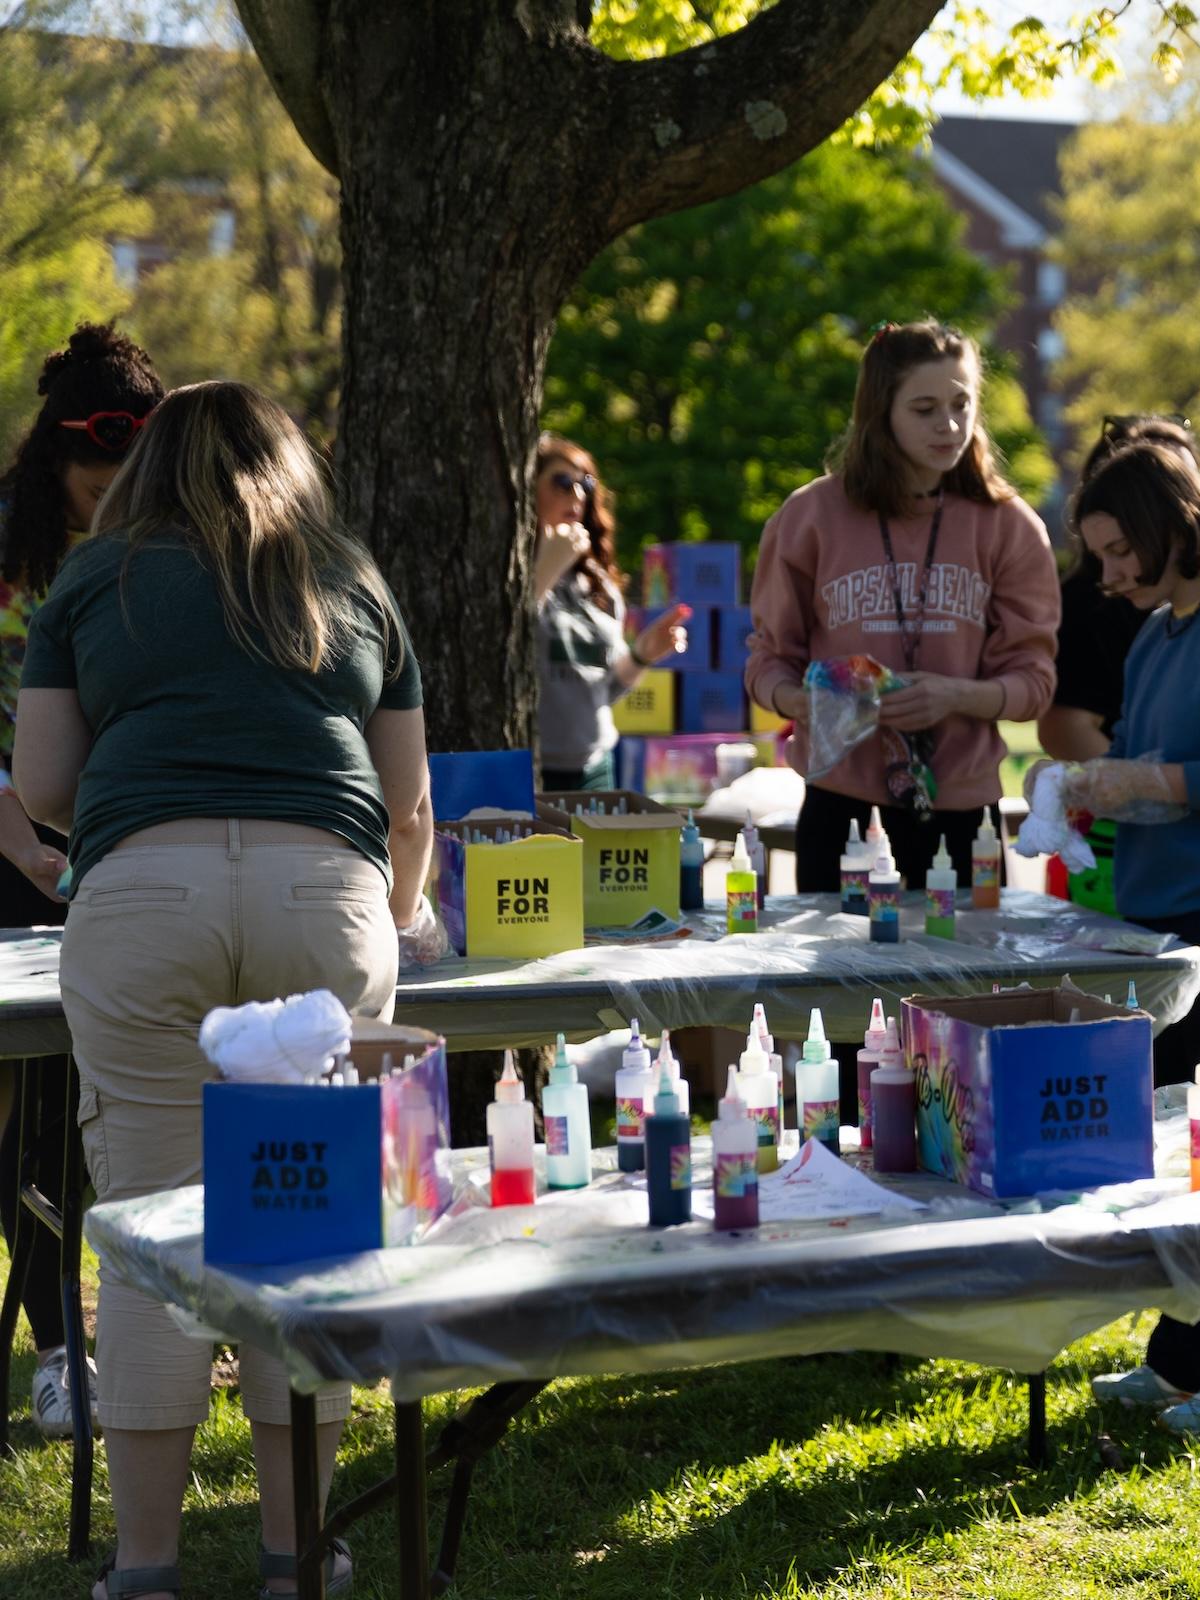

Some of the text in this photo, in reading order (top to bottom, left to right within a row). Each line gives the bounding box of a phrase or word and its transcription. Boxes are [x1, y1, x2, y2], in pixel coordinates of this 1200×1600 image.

[923, 563, 992, 629] BEAC
[600, 849, 648, 866] FUN
[600, 867, 648, 884] FOR
[497, 878, 549, 896] FUN
[600, 885, 648, 893] EVERYONE
[497, 897, 549, 916] FOR
[497, 916, 549, 925] EVERYONE
[1039, 1075, 1107, 1098] JUST
[1040, 1098, 1109, 1124] ADD
[1040, 1123, 1110, 1142] WATER
[250, 1141, 328, 1162] JUST
[251, 1165, 329, 1189] ADD
[251, 1194, 330, 1210] WATER
